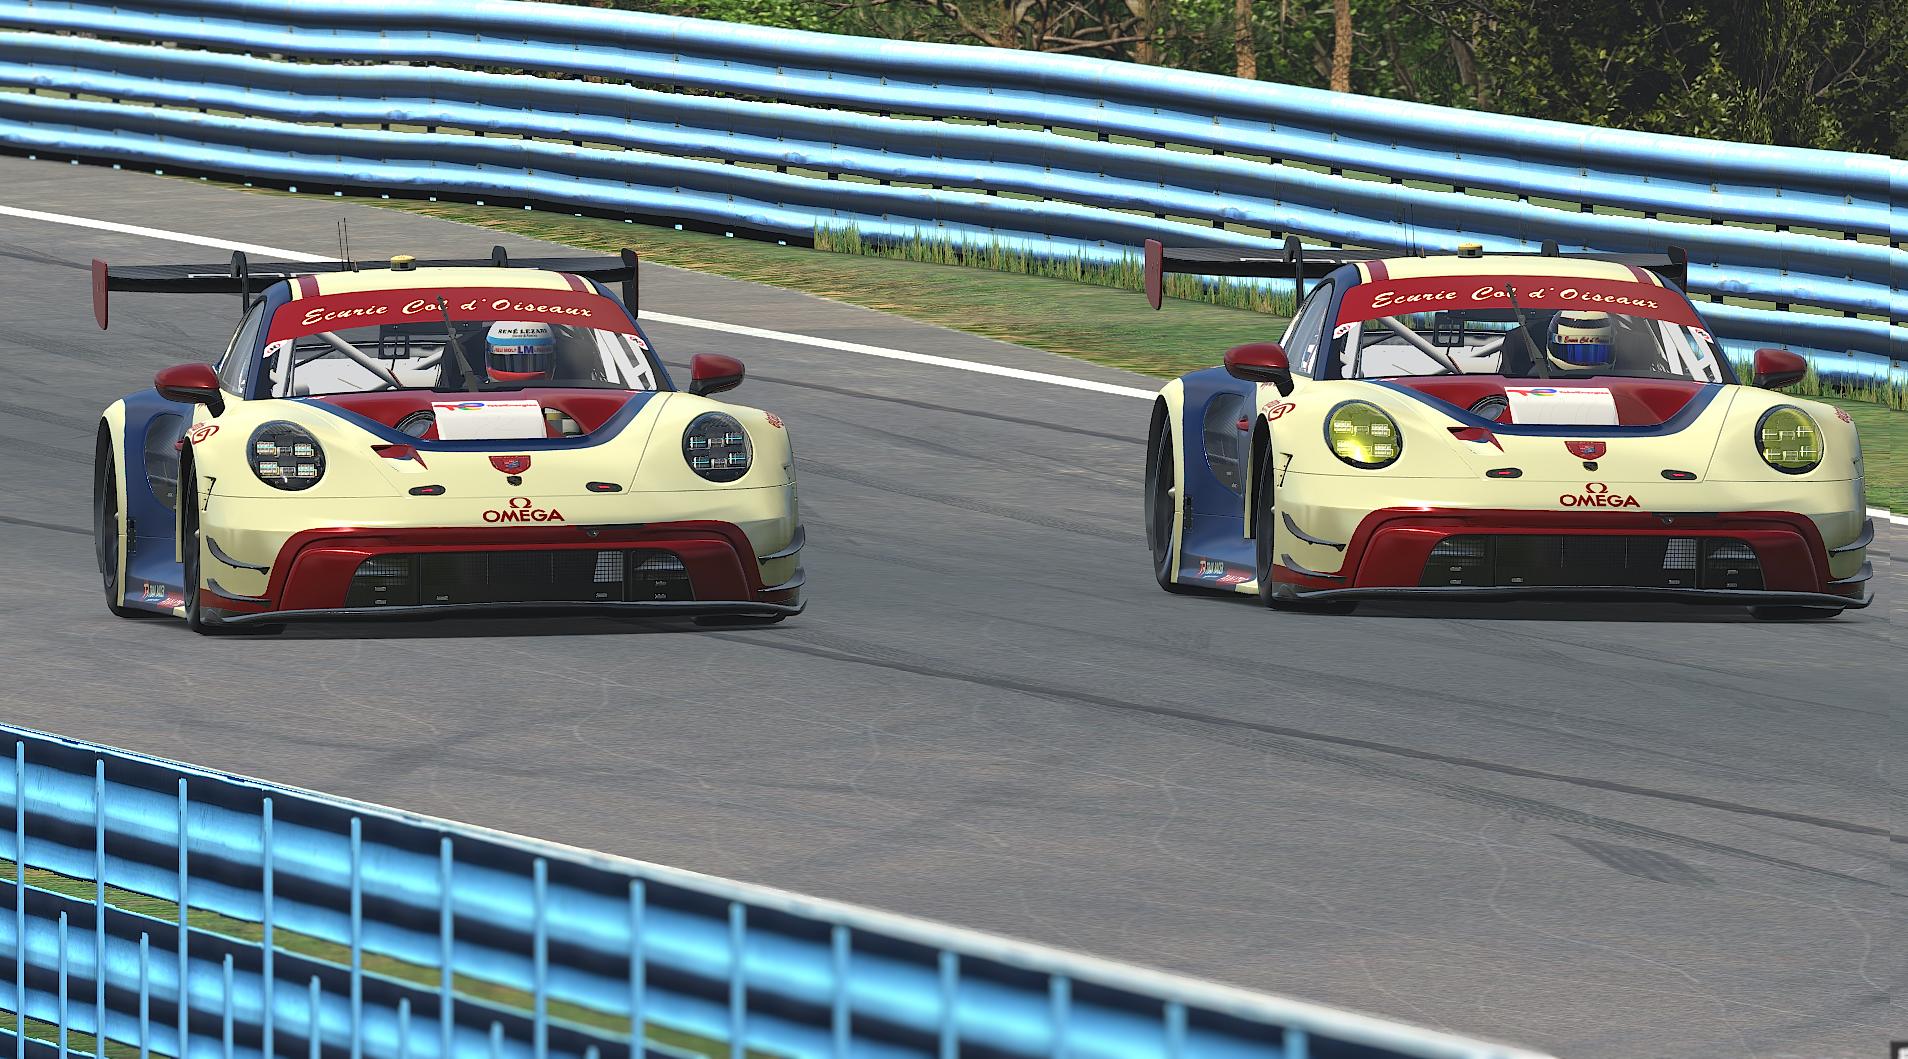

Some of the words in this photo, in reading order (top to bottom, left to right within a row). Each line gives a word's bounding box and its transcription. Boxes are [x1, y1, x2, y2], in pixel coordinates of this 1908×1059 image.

[1371, 291, 1457, 309] Ecurie
[302, 306, 388, 325] Ecurie
[401, 298, 448, 314] Col
[1559, 494, 1641, 508] OMEGA
[482, 509, 565, 523] OMEGA
